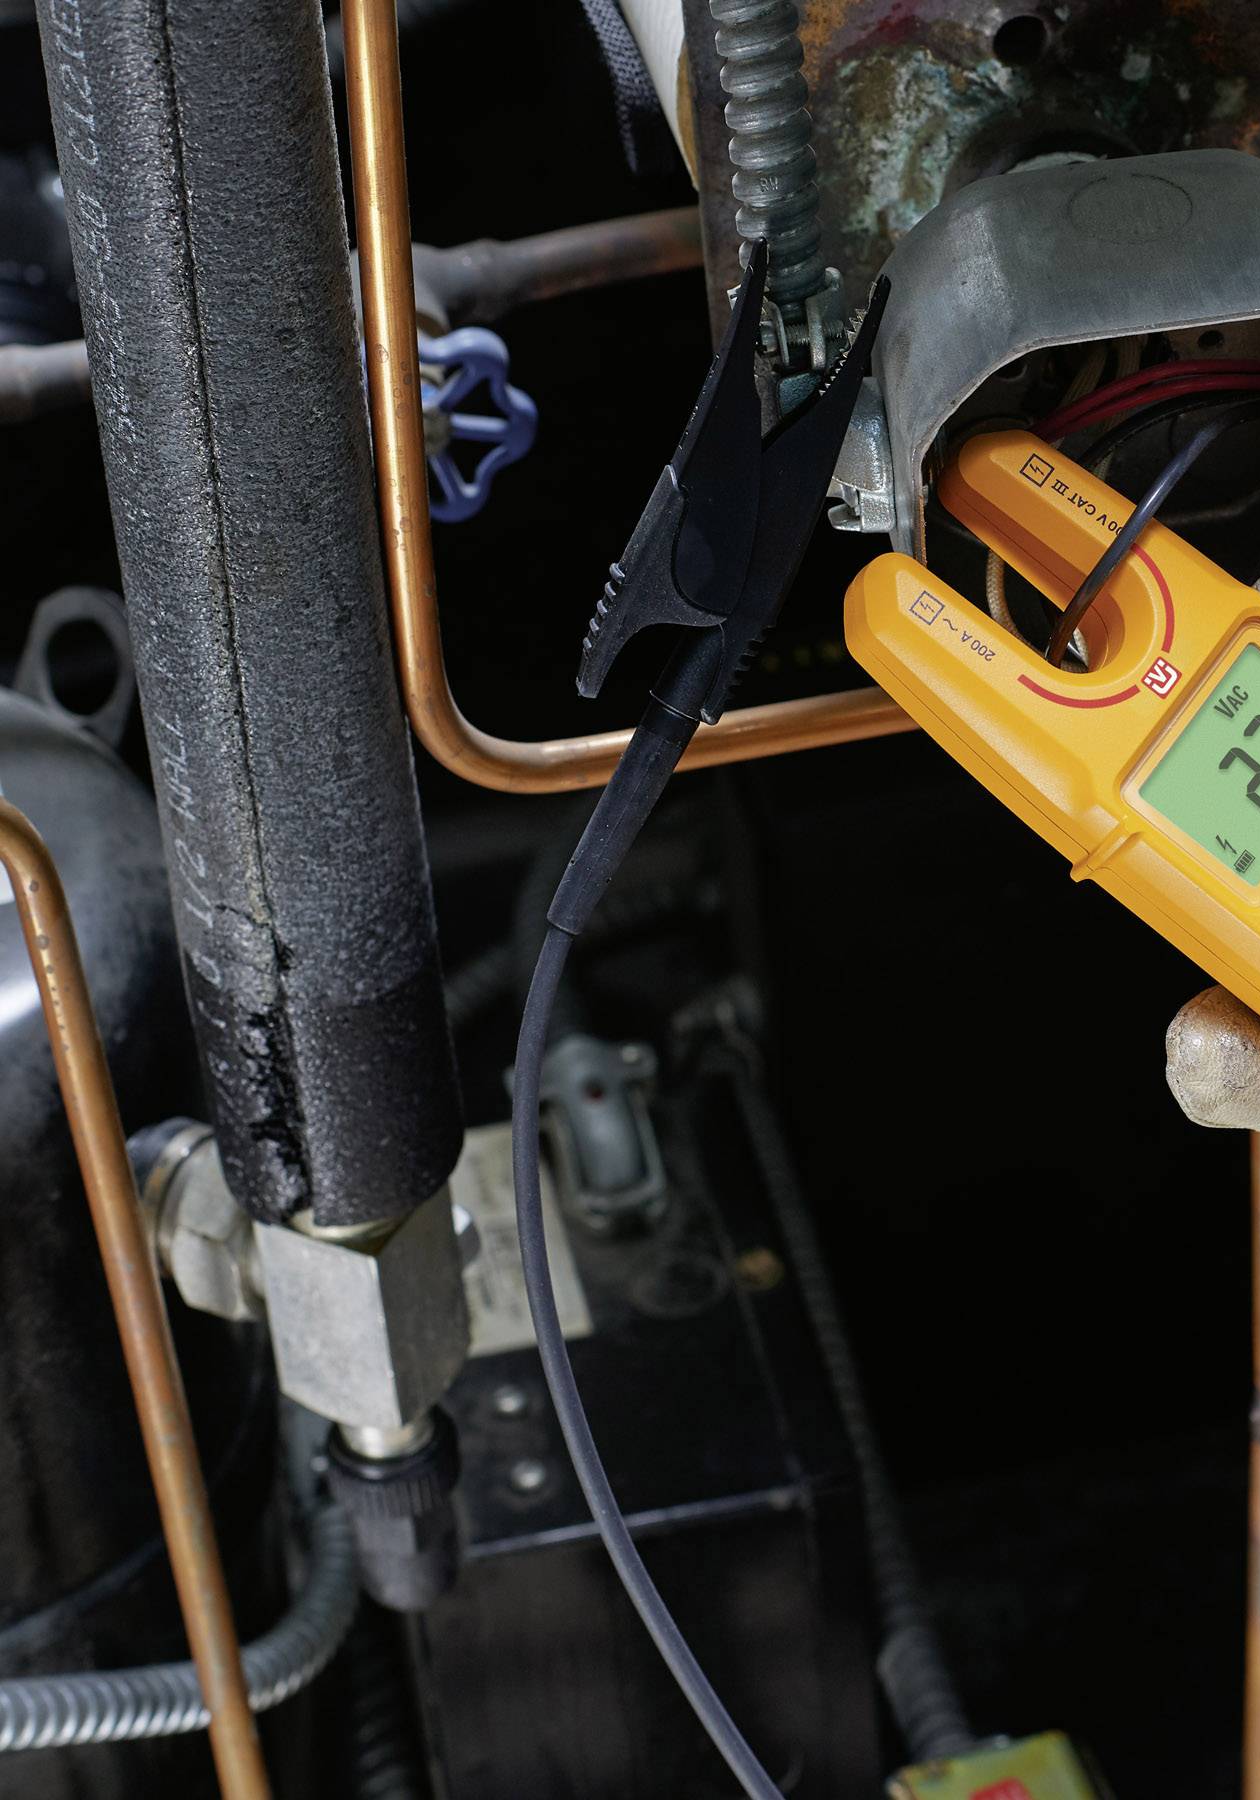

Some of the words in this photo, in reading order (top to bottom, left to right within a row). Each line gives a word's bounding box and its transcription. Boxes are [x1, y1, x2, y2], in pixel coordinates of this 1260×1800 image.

[1050, 478, 1071, 497] III
[1067, 492, 1097, 516] CAT
[1213, 685, 1249, 719] VAC
